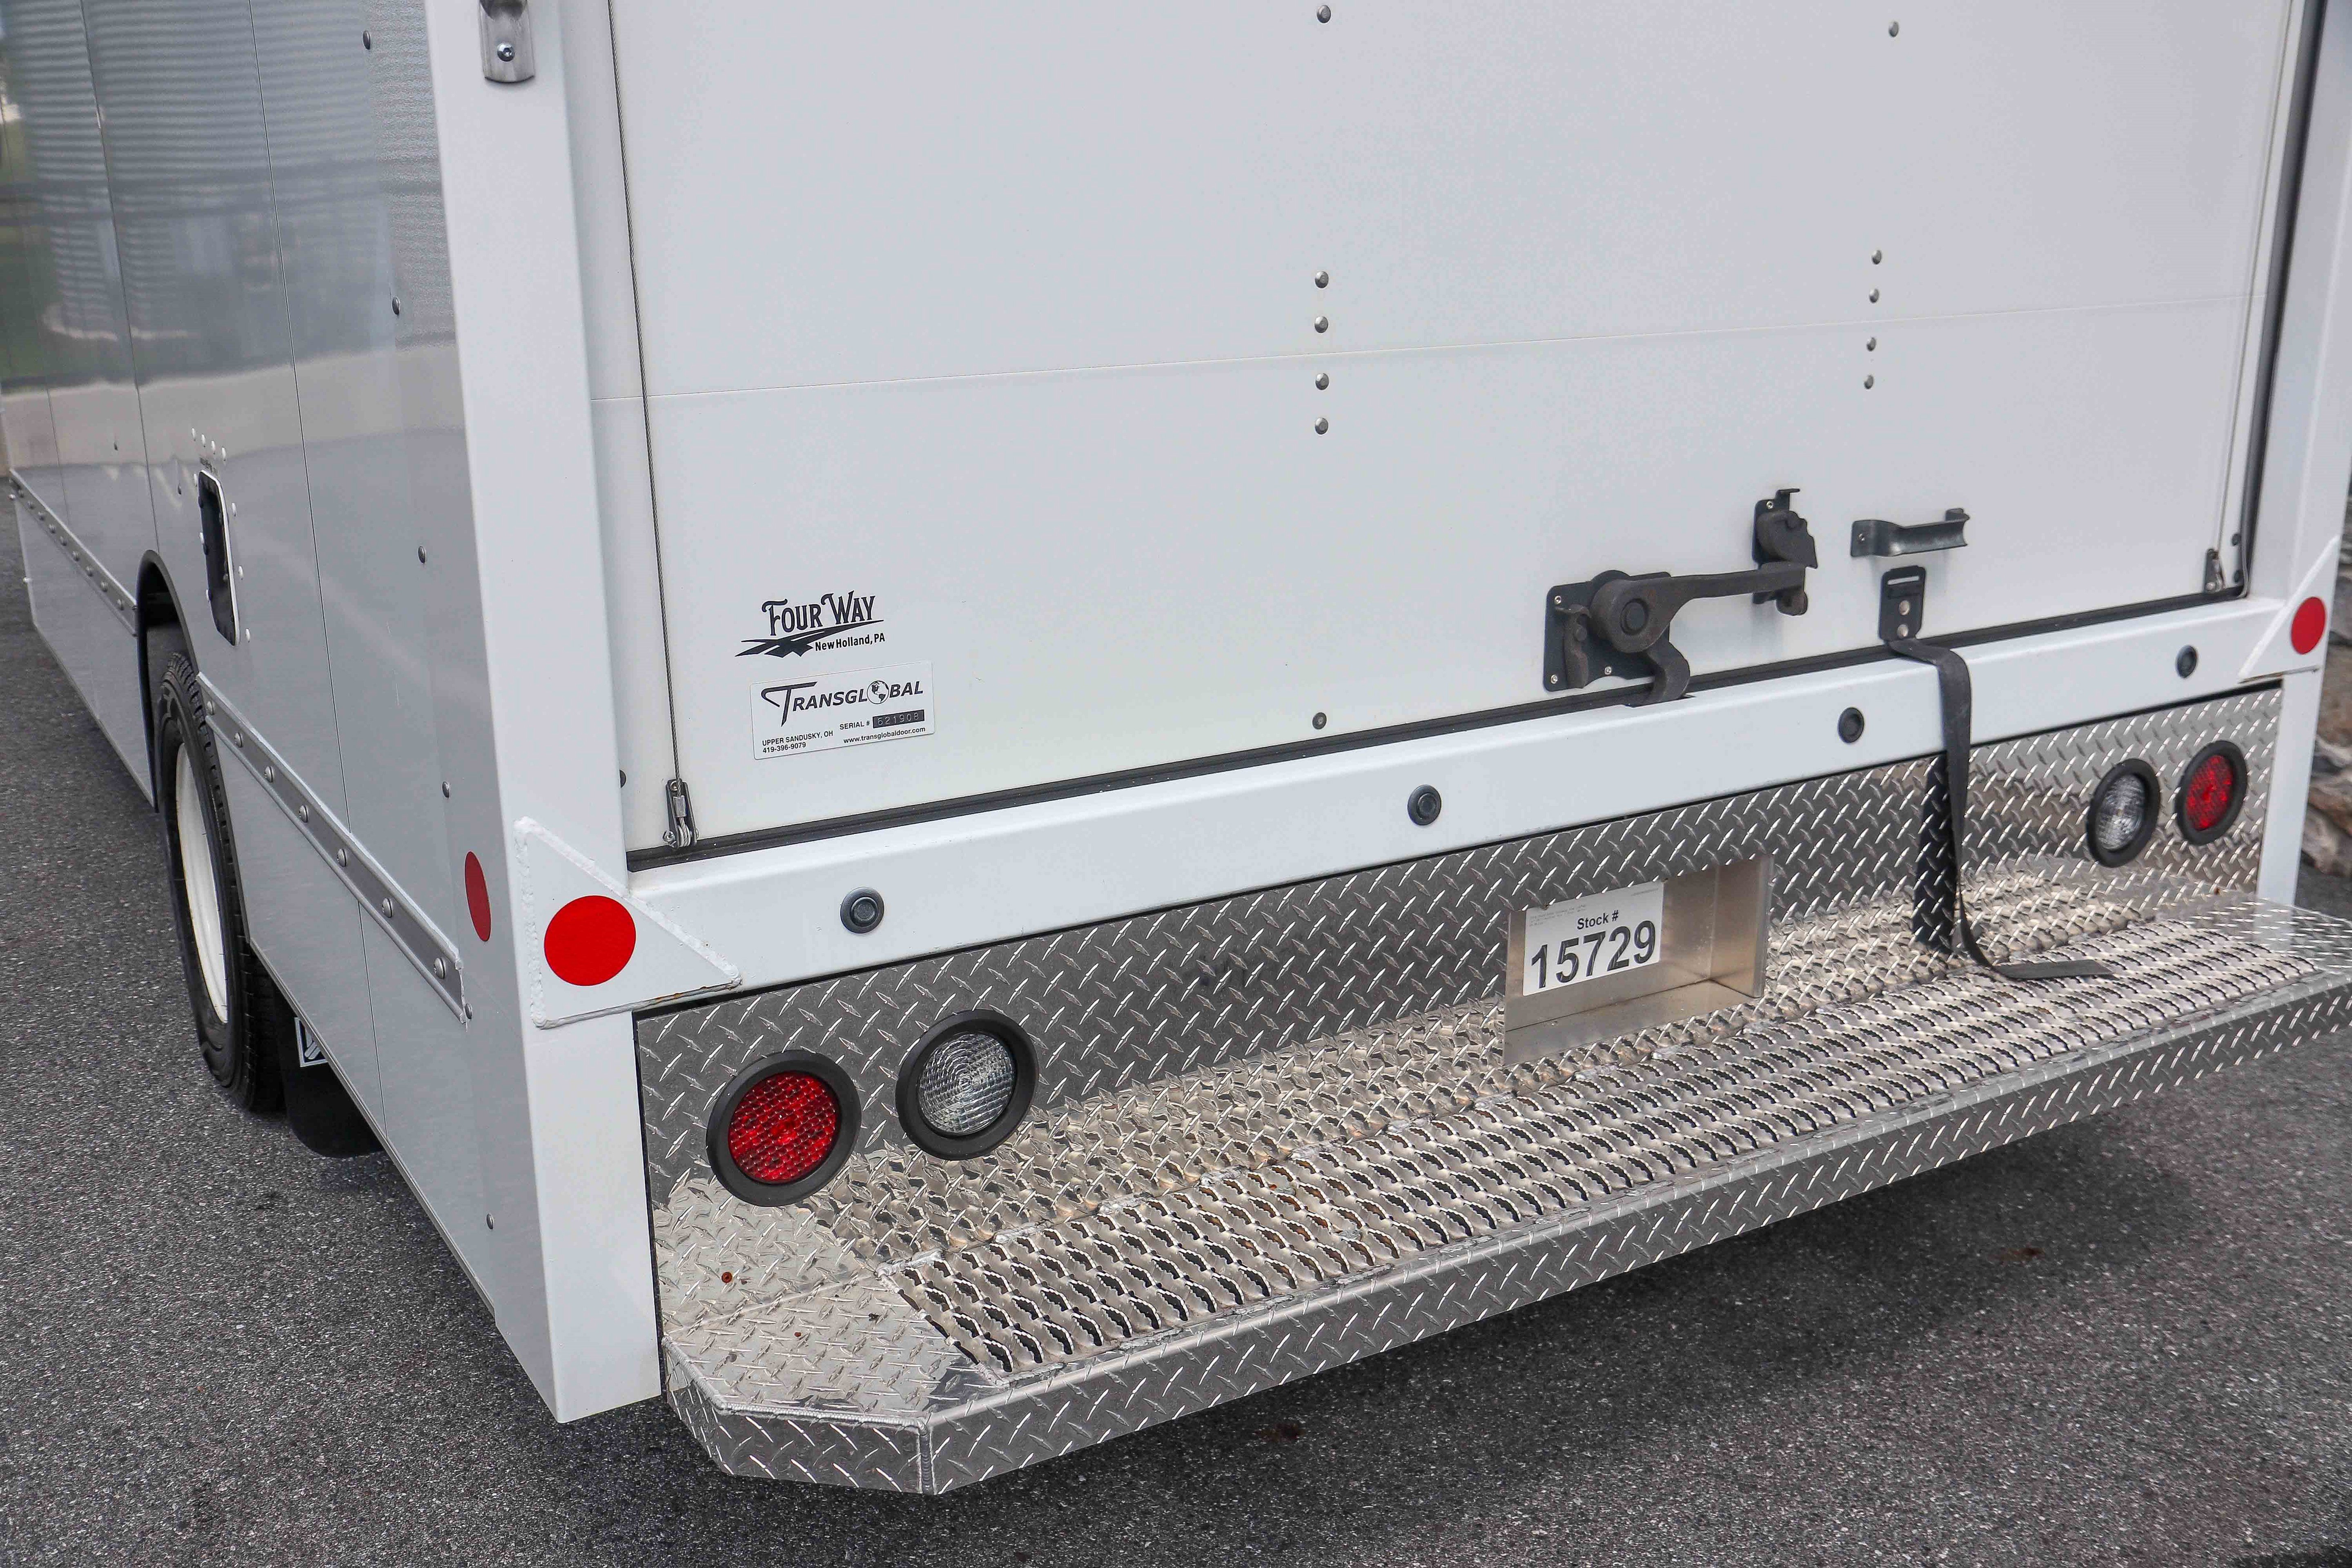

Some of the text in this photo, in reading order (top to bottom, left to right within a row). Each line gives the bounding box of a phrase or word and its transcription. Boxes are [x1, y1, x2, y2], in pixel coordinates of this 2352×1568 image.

[815, 633, 885, 651] New Holland, PA
[840, 721, 864, 730] SERIAL
[878, 713, 919, 725] 621908
[762, 737, 784, 746] UPPER
[786, 732, 822, 743] SANDUSKY,
[843, 727, 926, 744] www.transglobaldoor.com
[763, 742, 806, 753] 419-396-9079
[1577, 913, 1608, 930] Stock
[1612, 910, 1619, 922] #
[1531, 920, 1656, 989] 15729
